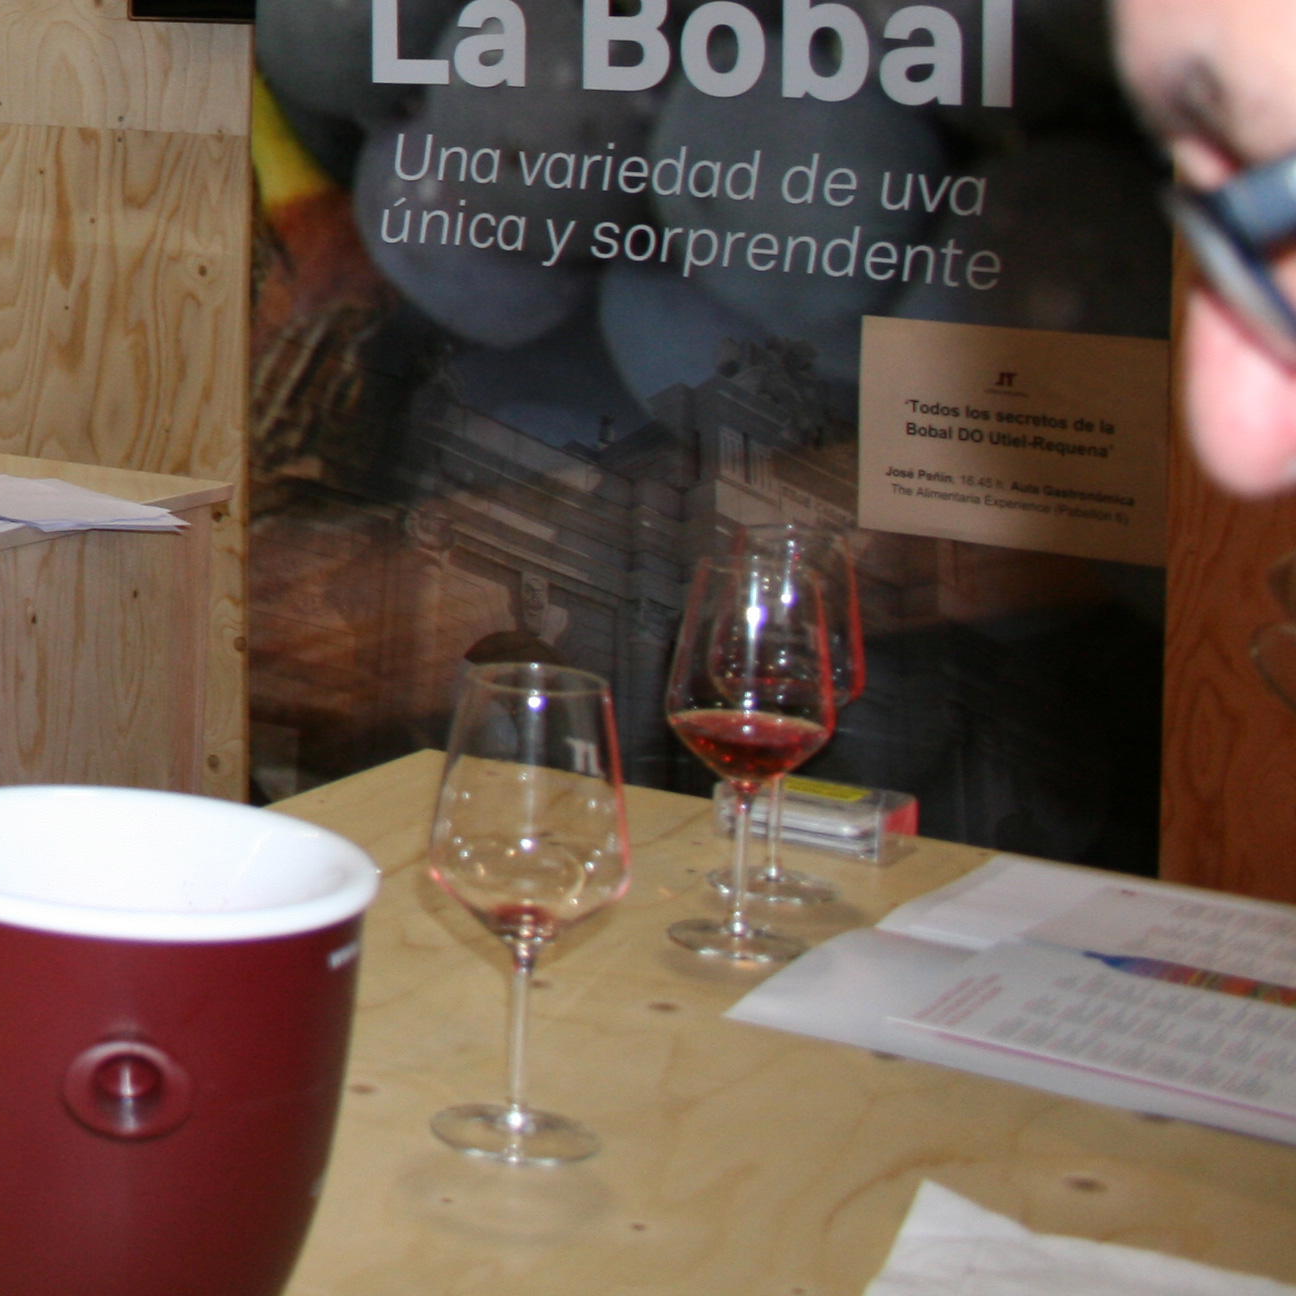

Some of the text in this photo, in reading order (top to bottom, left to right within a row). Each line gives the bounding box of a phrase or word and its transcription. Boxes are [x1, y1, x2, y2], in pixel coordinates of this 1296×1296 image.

[393, 132, 988, 216] Una variedad de uva
[379, 197, 1003, 290] única y sorprendente
[906, 422, 952, 440] Bobal
[958, 427, 984, 443] DO
[965, 405, 991, 421] los
[996, 410, 1068, 430] secretos
[1073, 418, 1095, 432] de
[1100, 419, 1115, 435] la
[891, 483, 913, 496] The
